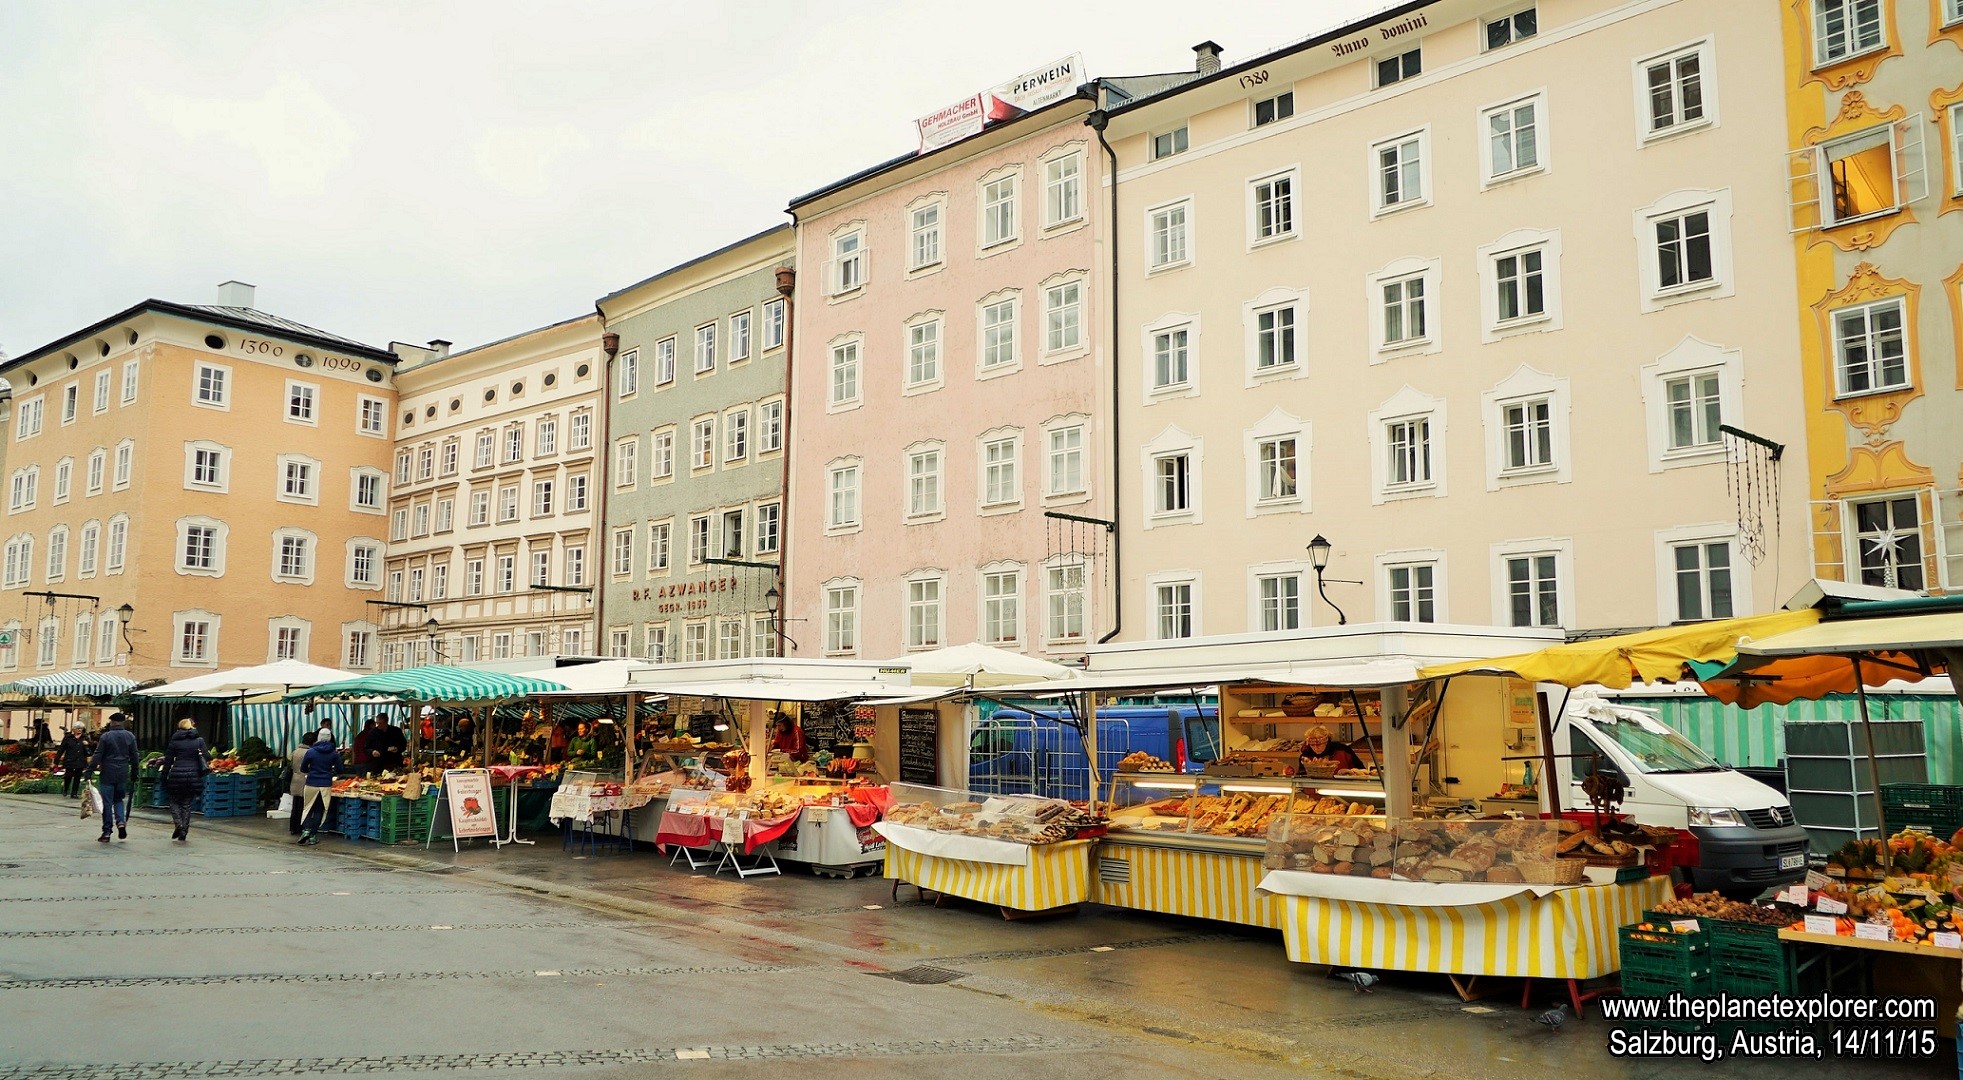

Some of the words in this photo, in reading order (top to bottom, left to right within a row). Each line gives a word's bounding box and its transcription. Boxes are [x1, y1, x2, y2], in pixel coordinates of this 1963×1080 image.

[1331, 37, 1369, 57] Anno
[1380, 13, 1428, 40] domini
[1013, 63, 1071, 95] PERWEIN
[1239, 69, 1269, 89] 1380
[922, 97, 977, 128] GEHMACHER
[938, 115, 962, 130] HOLZBAU
[962, 109, 979, 120] GmbH
[240, 338, 284, 358] 1360
[322, 356, 362, 373] 1999
[659, 576, 738, 599] AZWANGER
